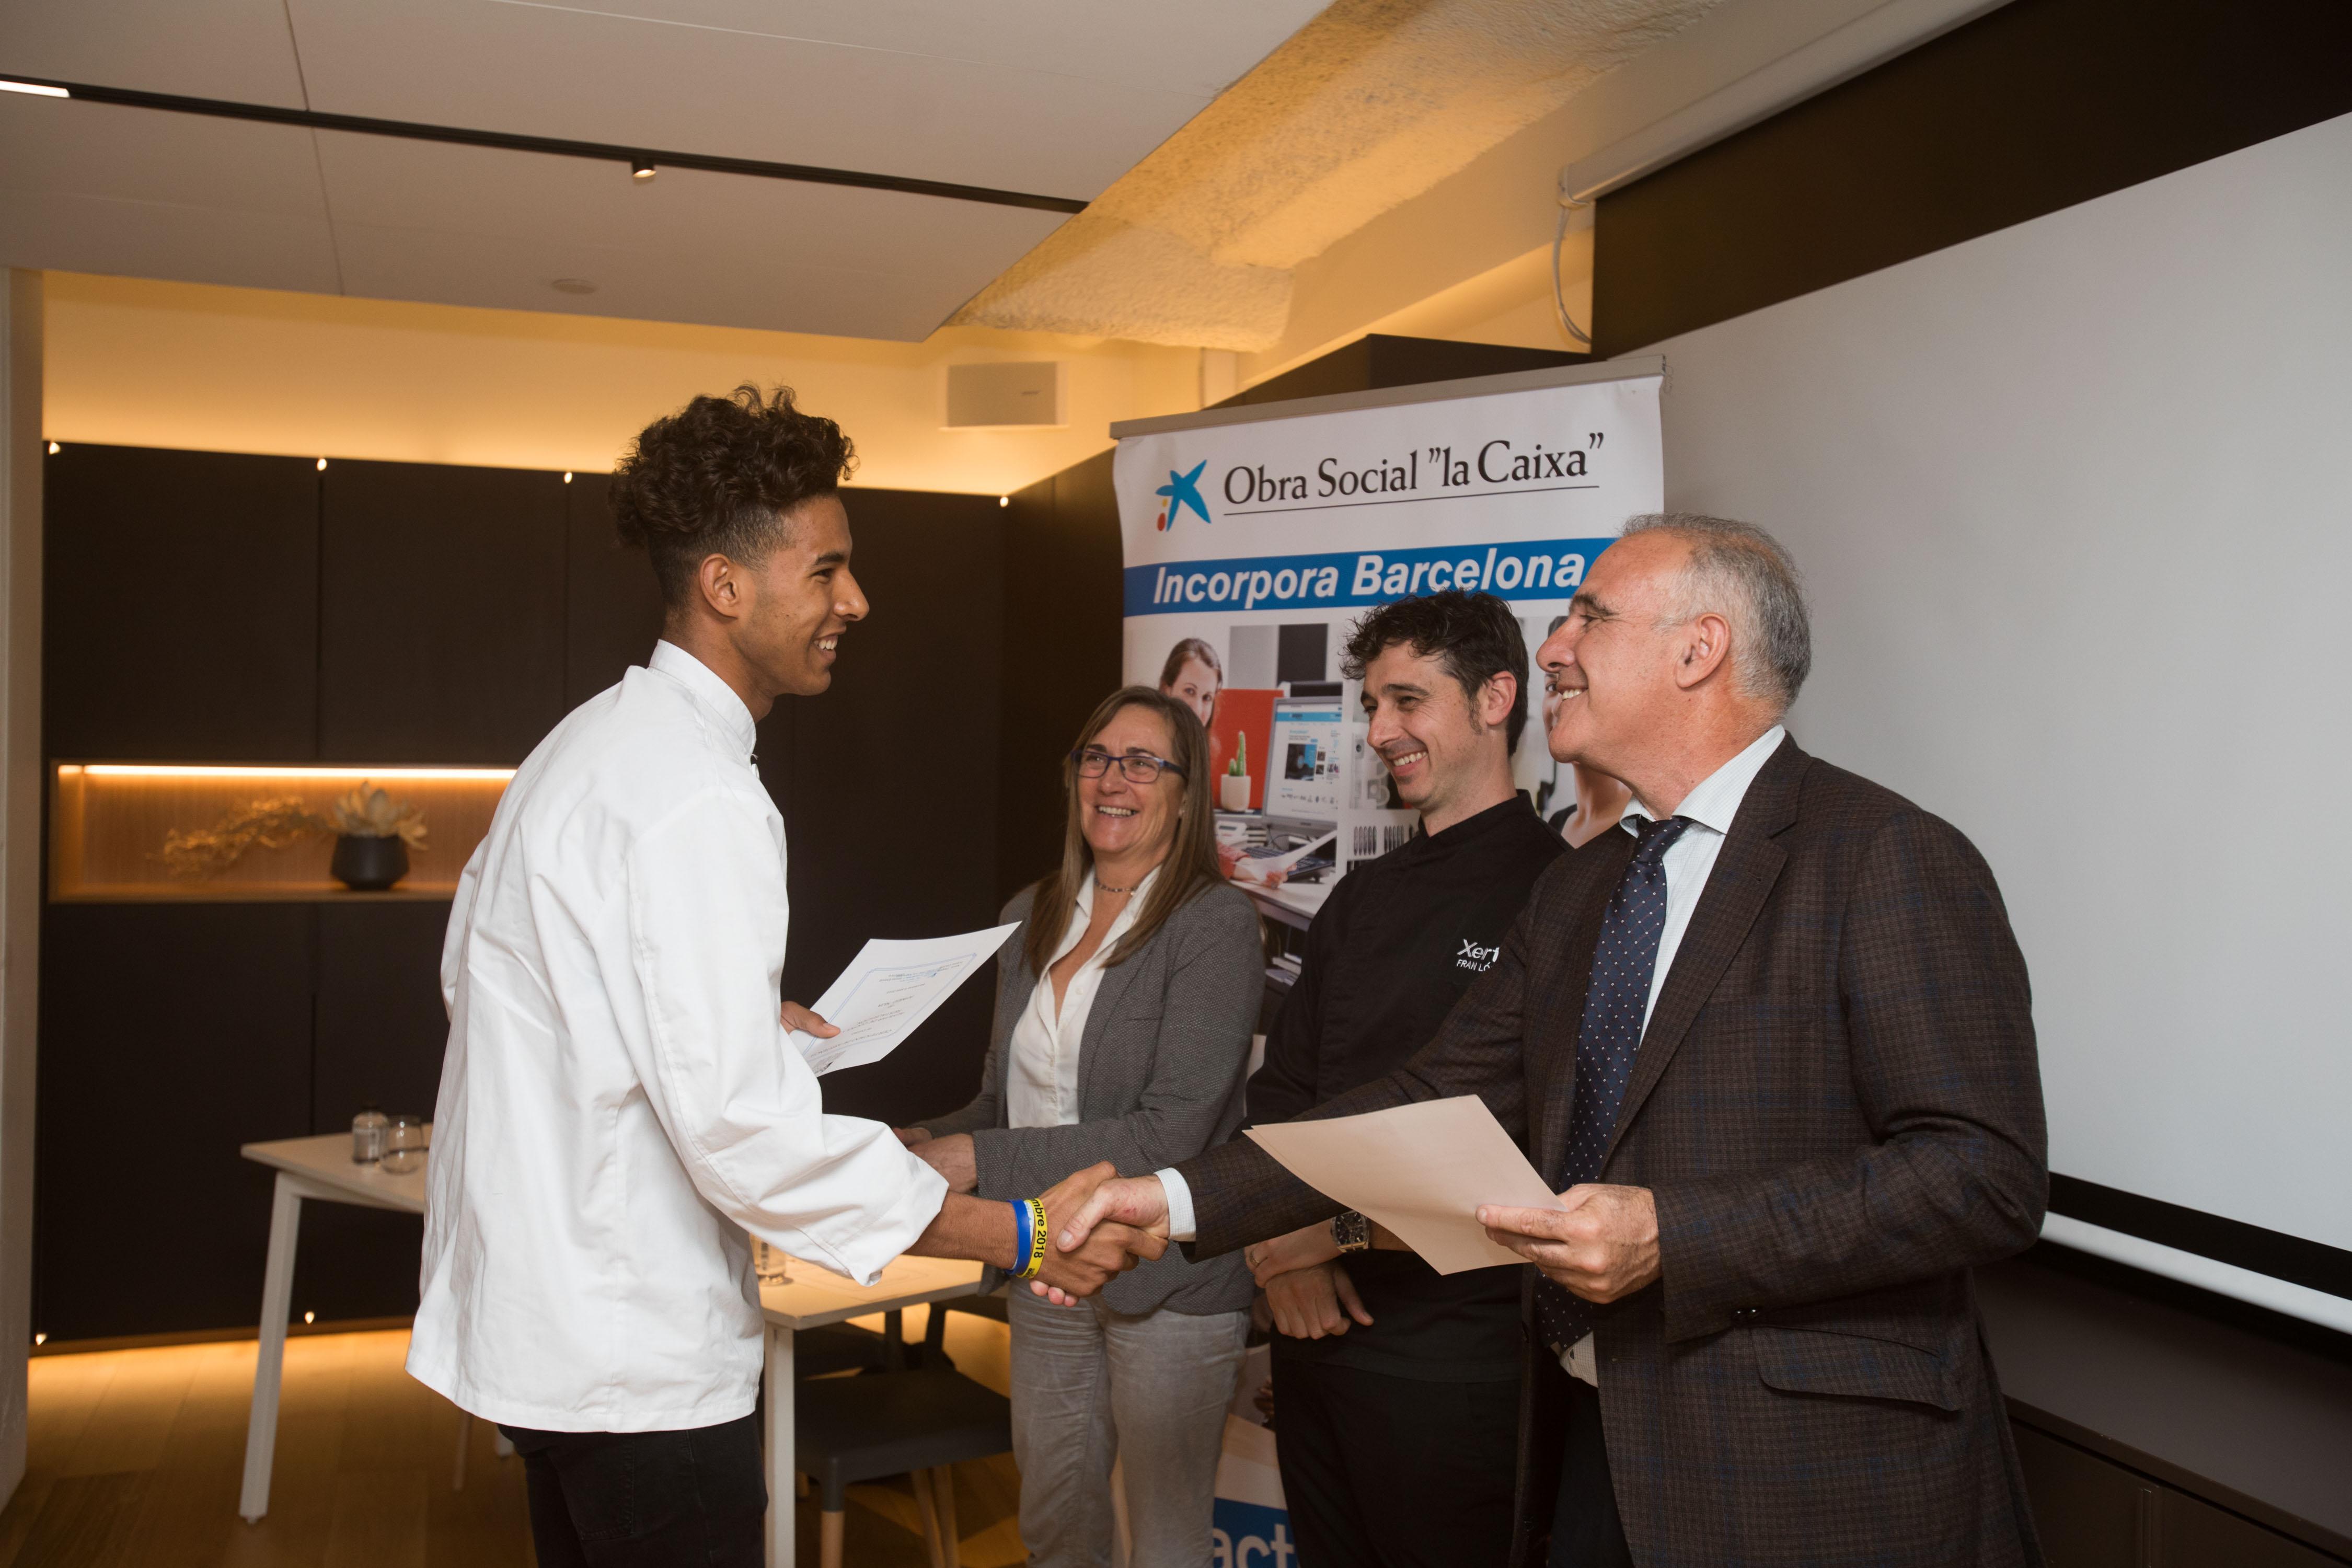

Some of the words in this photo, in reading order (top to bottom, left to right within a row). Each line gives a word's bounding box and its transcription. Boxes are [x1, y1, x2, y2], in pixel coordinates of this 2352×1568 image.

[1224, 465, 1308, 505] Obra
[1318, 450, 1417, 498] Social
[1154, 567, 1339, 610] Incorpora
[1352, 548, 1585, 596] Barcelona
[1456, 959, 1478, 971] FRAN
[1031, 1198, 1044, 1227] mbre
[1033, 1230, 1047, 1259] 2018
[1212, 1523, 1298, 1568] act
